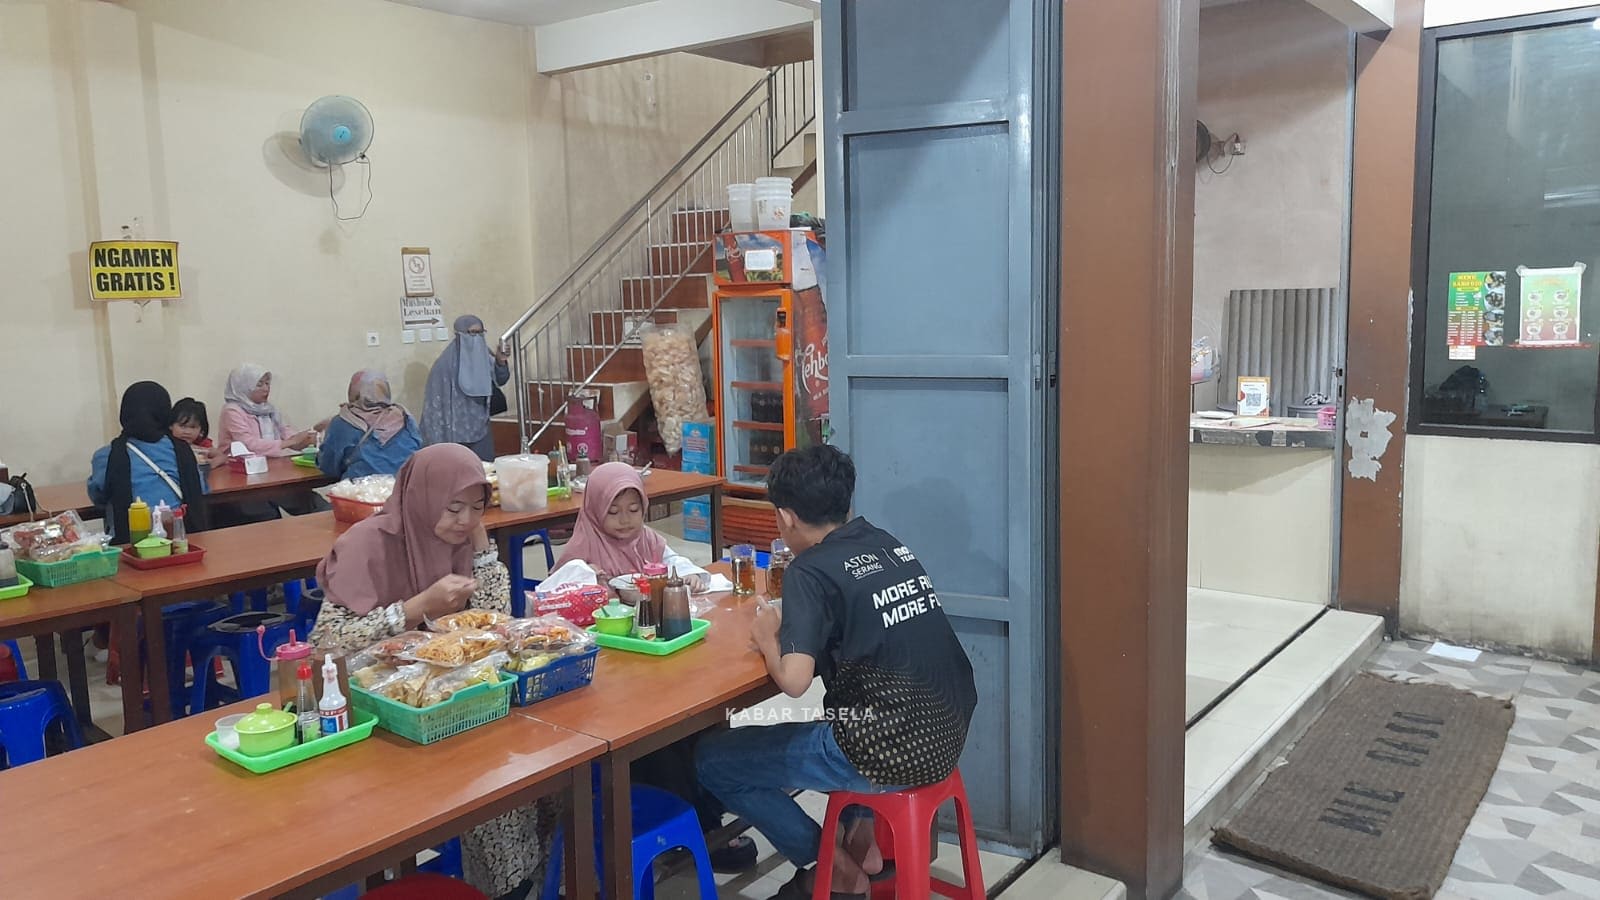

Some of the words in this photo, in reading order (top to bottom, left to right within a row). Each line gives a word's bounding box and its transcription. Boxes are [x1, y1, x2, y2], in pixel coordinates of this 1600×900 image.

[94, 248, 173, 268] NGAMEN
[96, 272, 165, 292] GRATIS
[169, 272, 176, 290] !
[844, 554, 879, 571] ASTON
[851, 562, 882, 576] SERANG
[872, 579, 918, 610] MORE
[918, 575, 932, 591] RU
[882, 596, 928, 629] MORE
